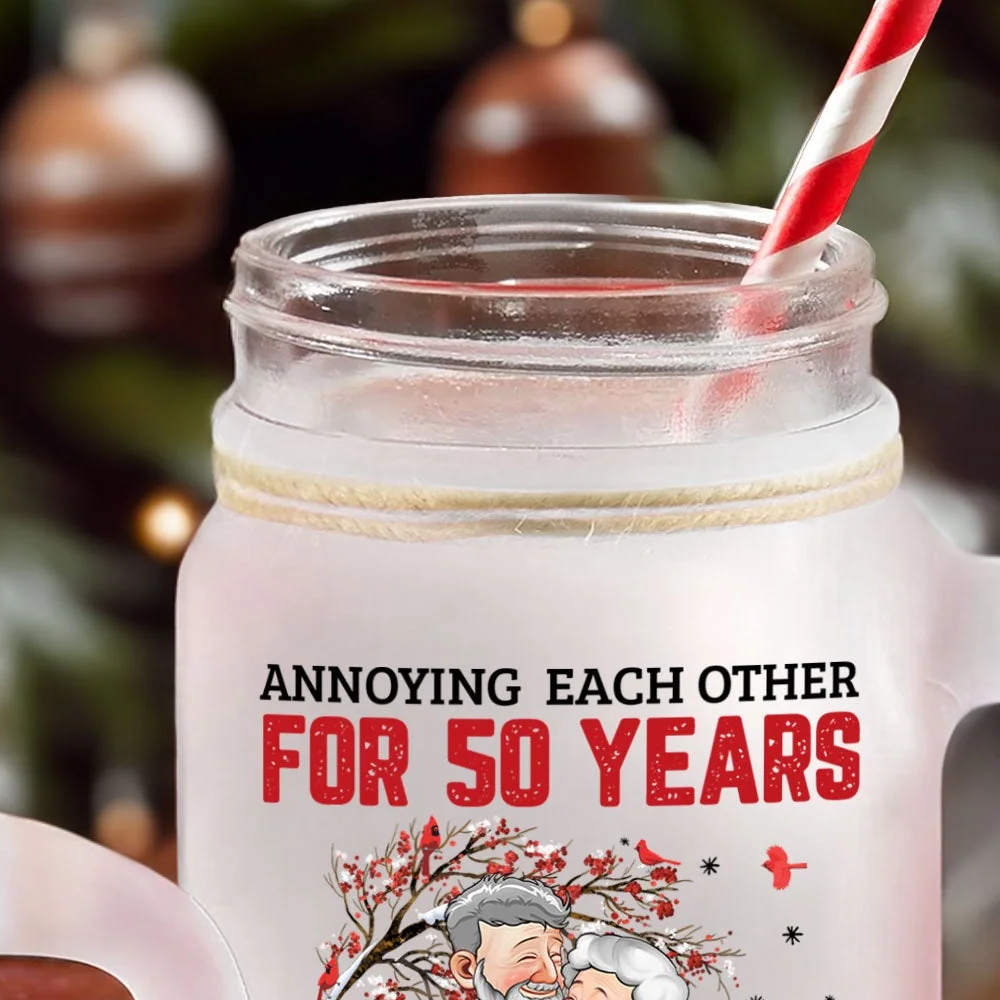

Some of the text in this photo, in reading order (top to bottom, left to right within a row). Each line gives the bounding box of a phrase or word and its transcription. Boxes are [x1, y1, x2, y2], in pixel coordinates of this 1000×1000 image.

[259, 661, 860, 707] ANNOYING EACH OTHER
[262, 711, 861, 808] FOR 50 YEARS
